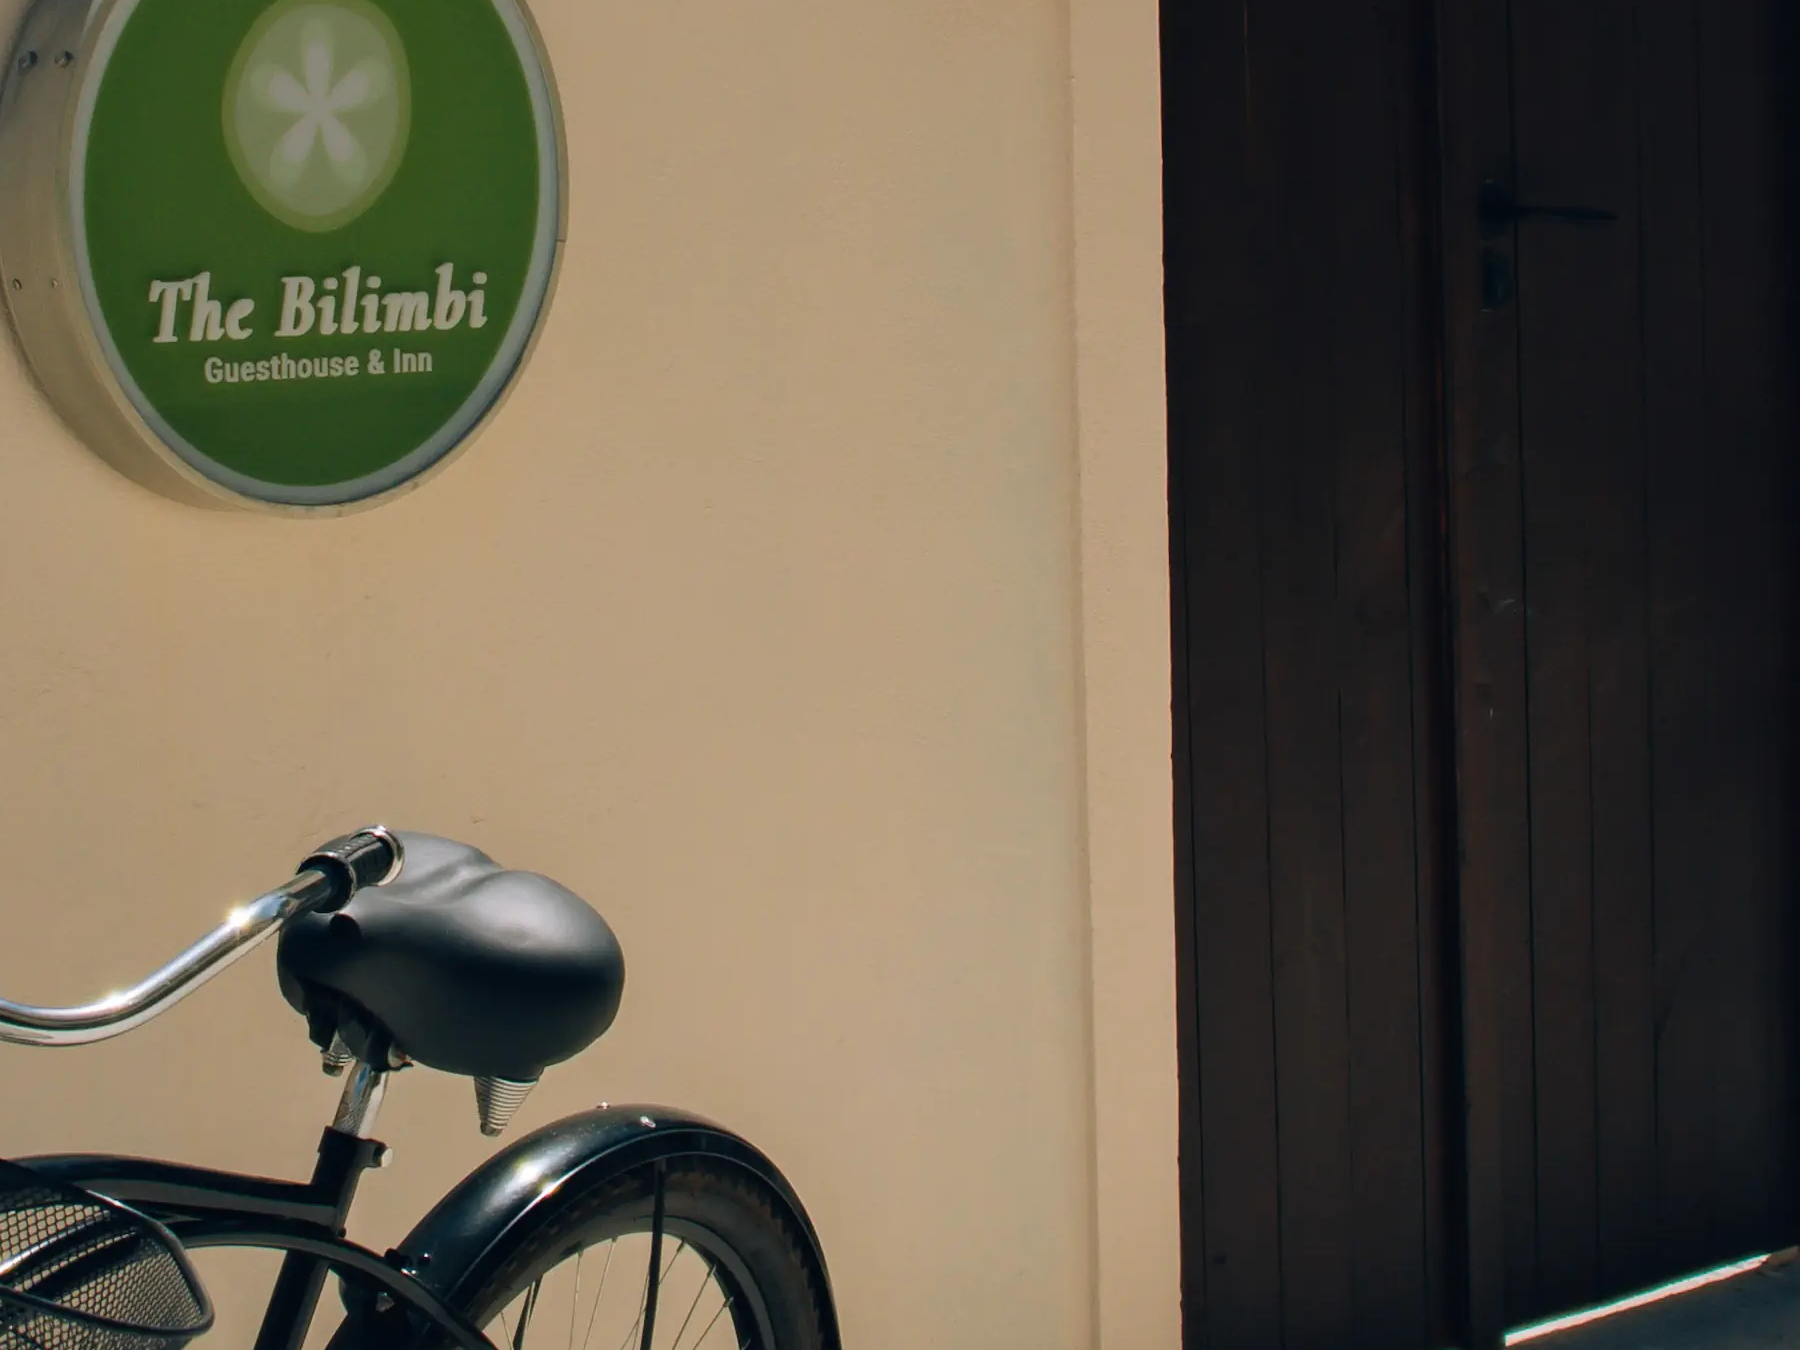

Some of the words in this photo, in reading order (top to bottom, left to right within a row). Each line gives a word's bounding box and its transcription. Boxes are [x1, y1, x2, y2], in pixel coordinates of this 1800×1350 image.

[149, 271, 255, 343] The
[274, 262, 488, 337] Bilimbi
[204, 352, 359, 383] Guesthouse
[367, 350, 385, 375] &
[394, 348, 433, 373] Inn
